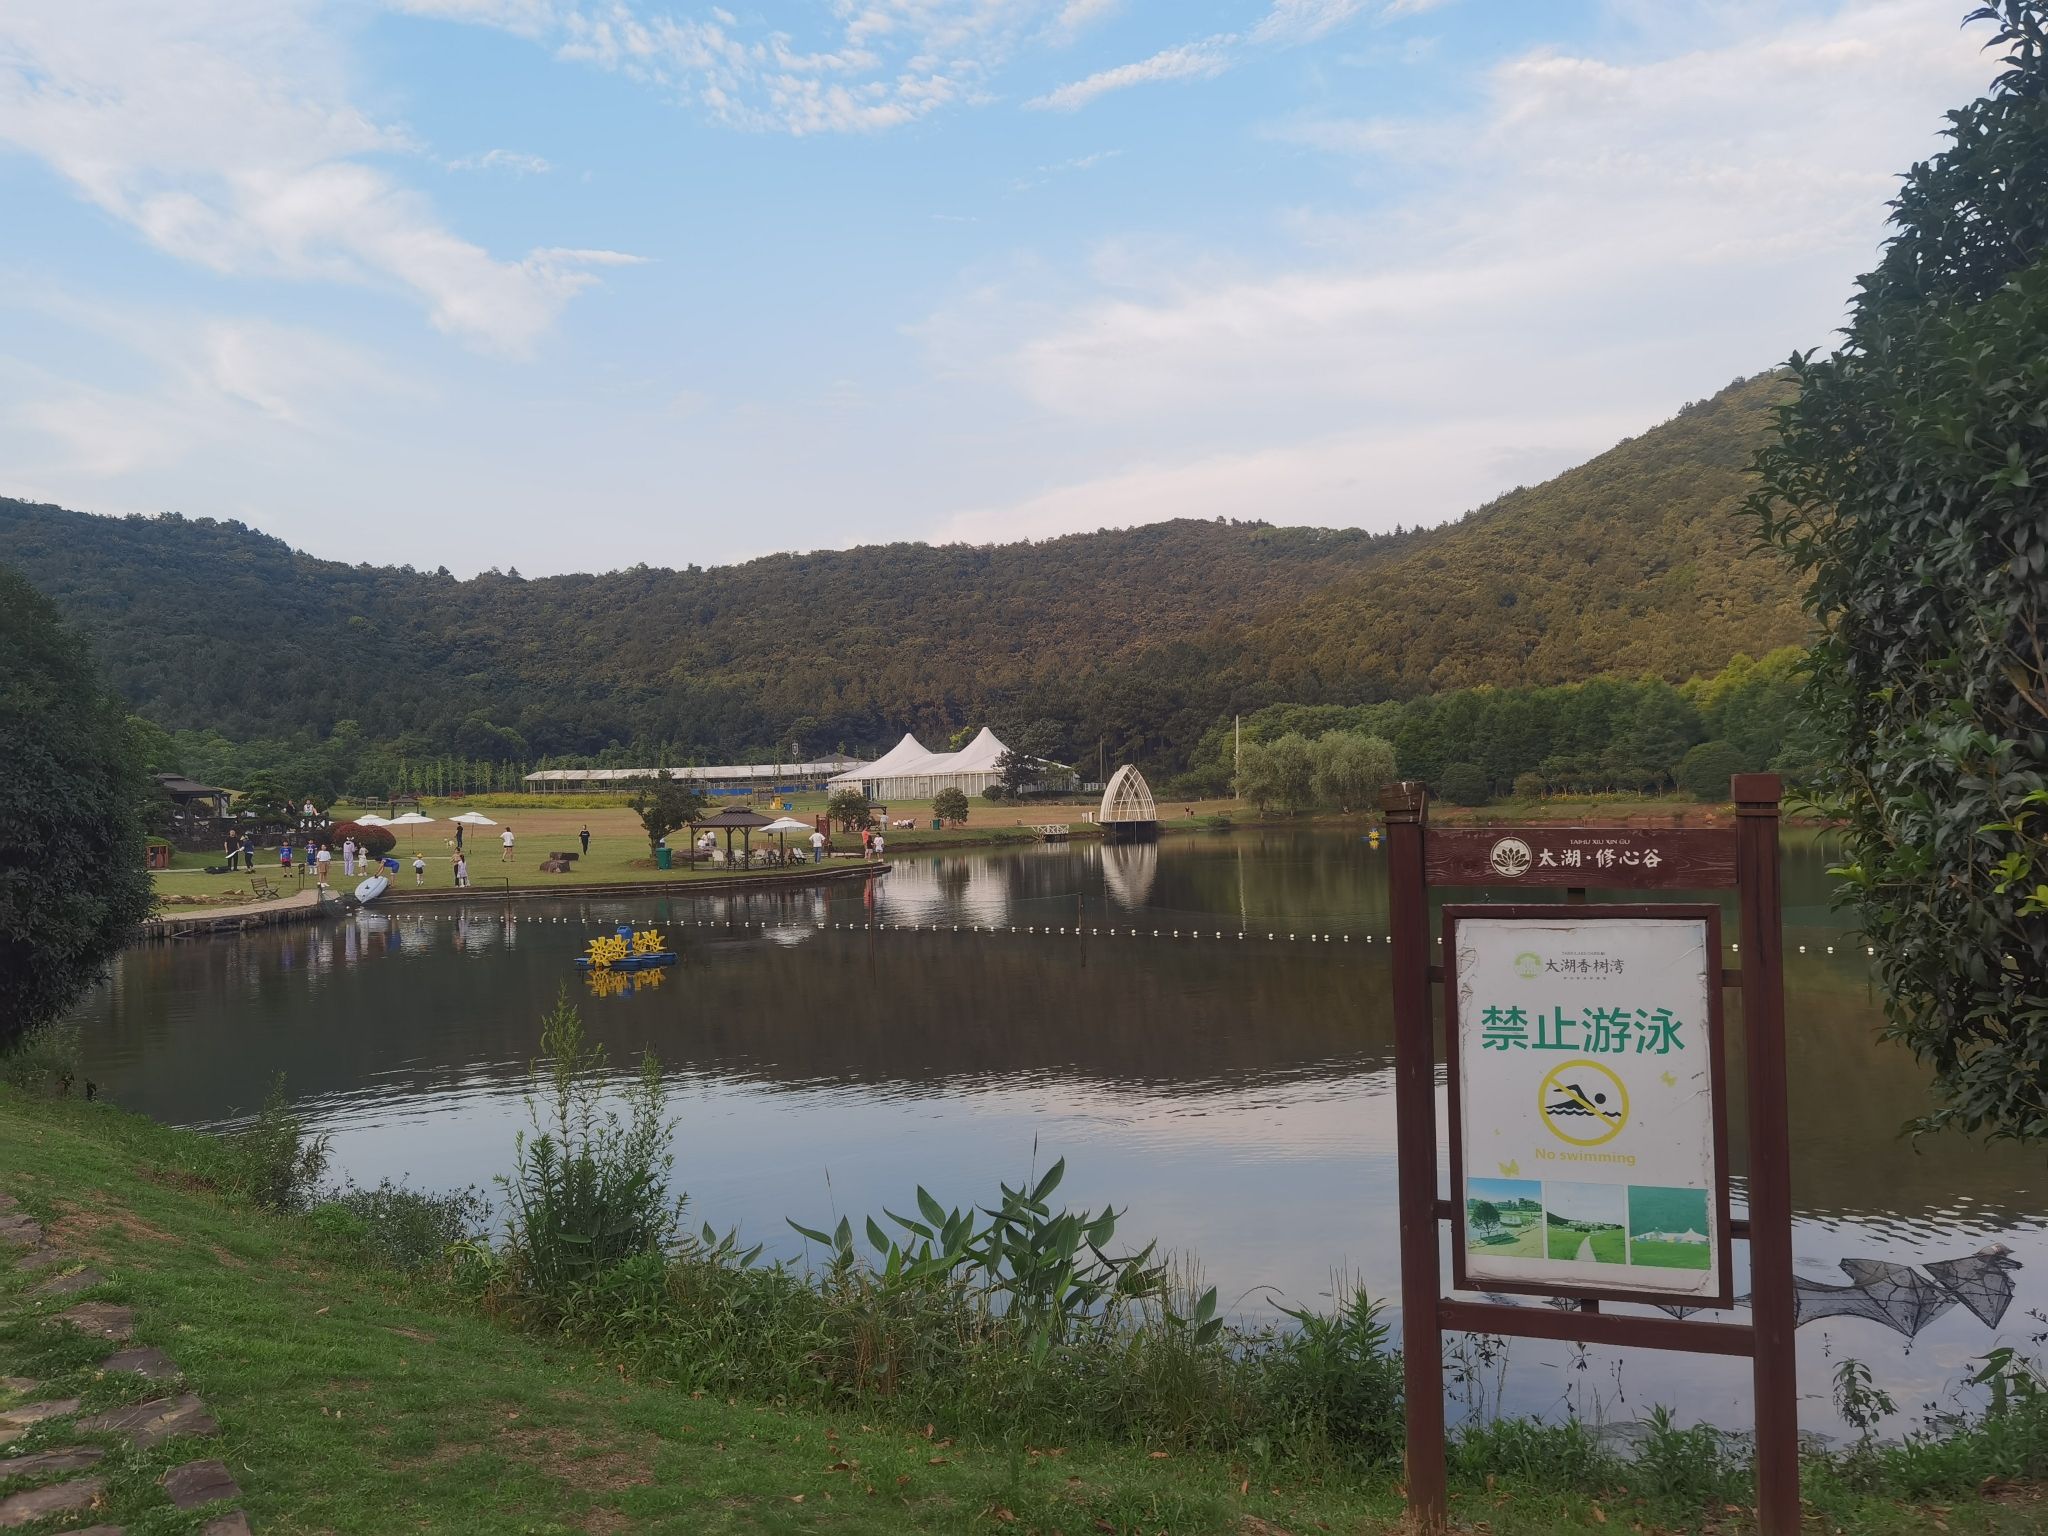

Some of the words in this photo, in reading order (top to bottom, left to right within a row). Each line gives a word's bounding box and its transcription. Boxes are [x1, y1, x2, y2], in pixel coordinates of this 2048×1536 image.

[1545, 958, 1625, 974] 太湖香树湾
[1481, 1005, 1685, 1055] 禁止游泳
[1535, 1148, 1556, 1160] No
[1560, 1150, 1636, 1167] swimming
